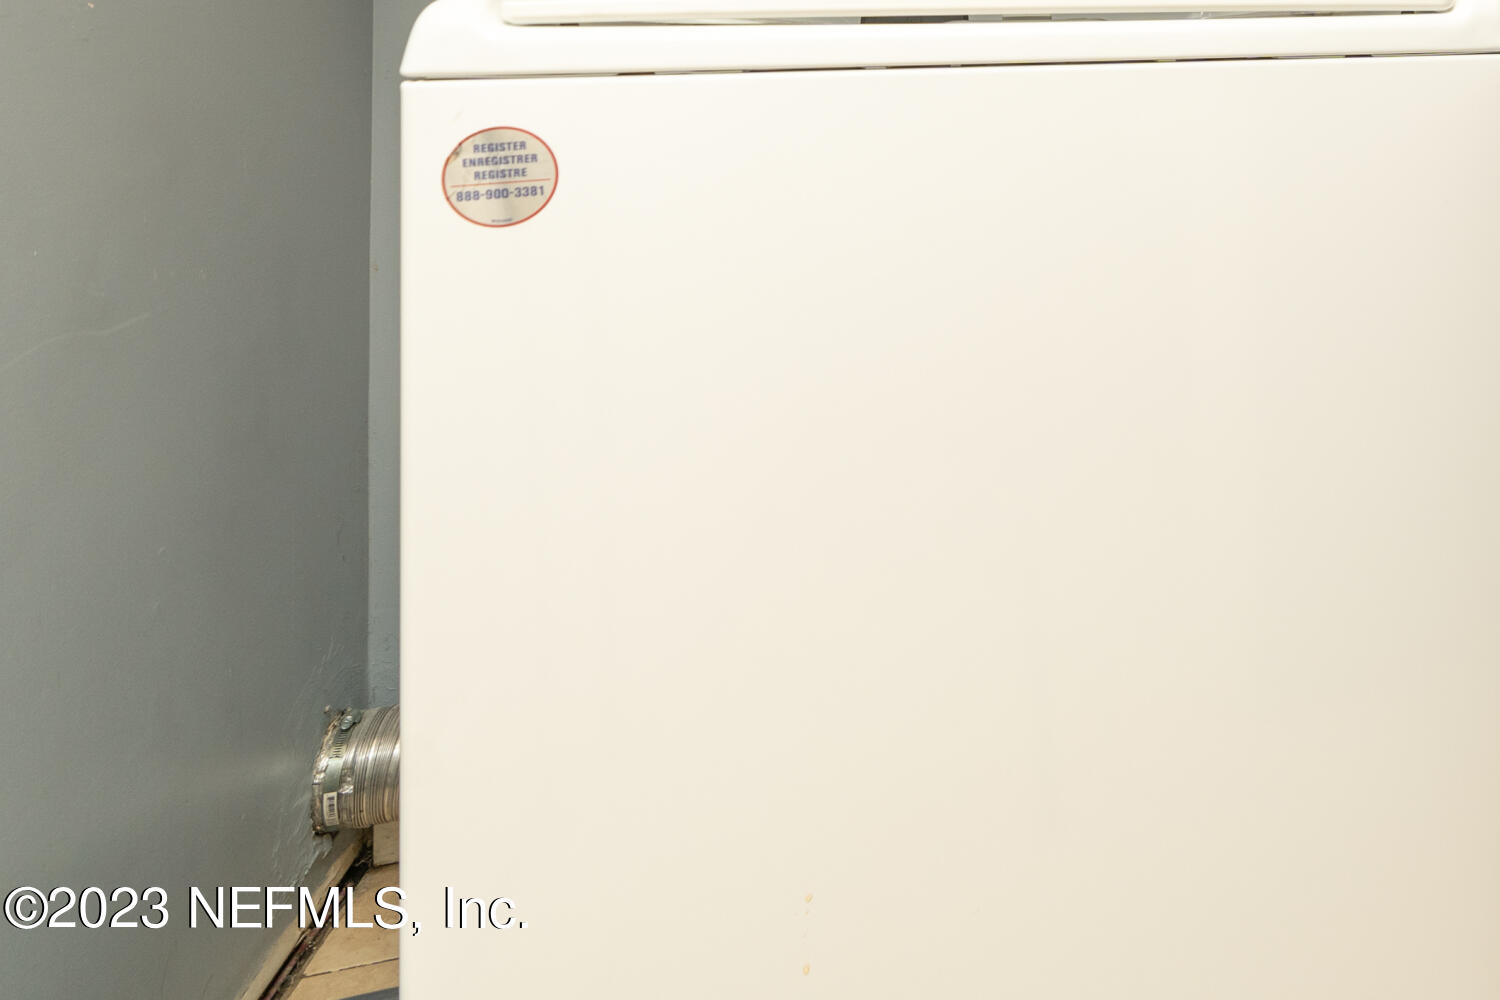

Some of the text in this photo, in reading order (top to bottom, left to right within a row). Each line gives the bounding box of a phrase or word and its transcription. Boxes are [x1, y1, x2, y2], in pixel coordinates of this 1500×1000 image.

[473, 140, 527, 153] REGISTER
[461, 153, 539, 168] ENREGISTRER
[473, 167, 528, 181] REGISTRE
[455, 185, 546, 202] 888-900-3381
